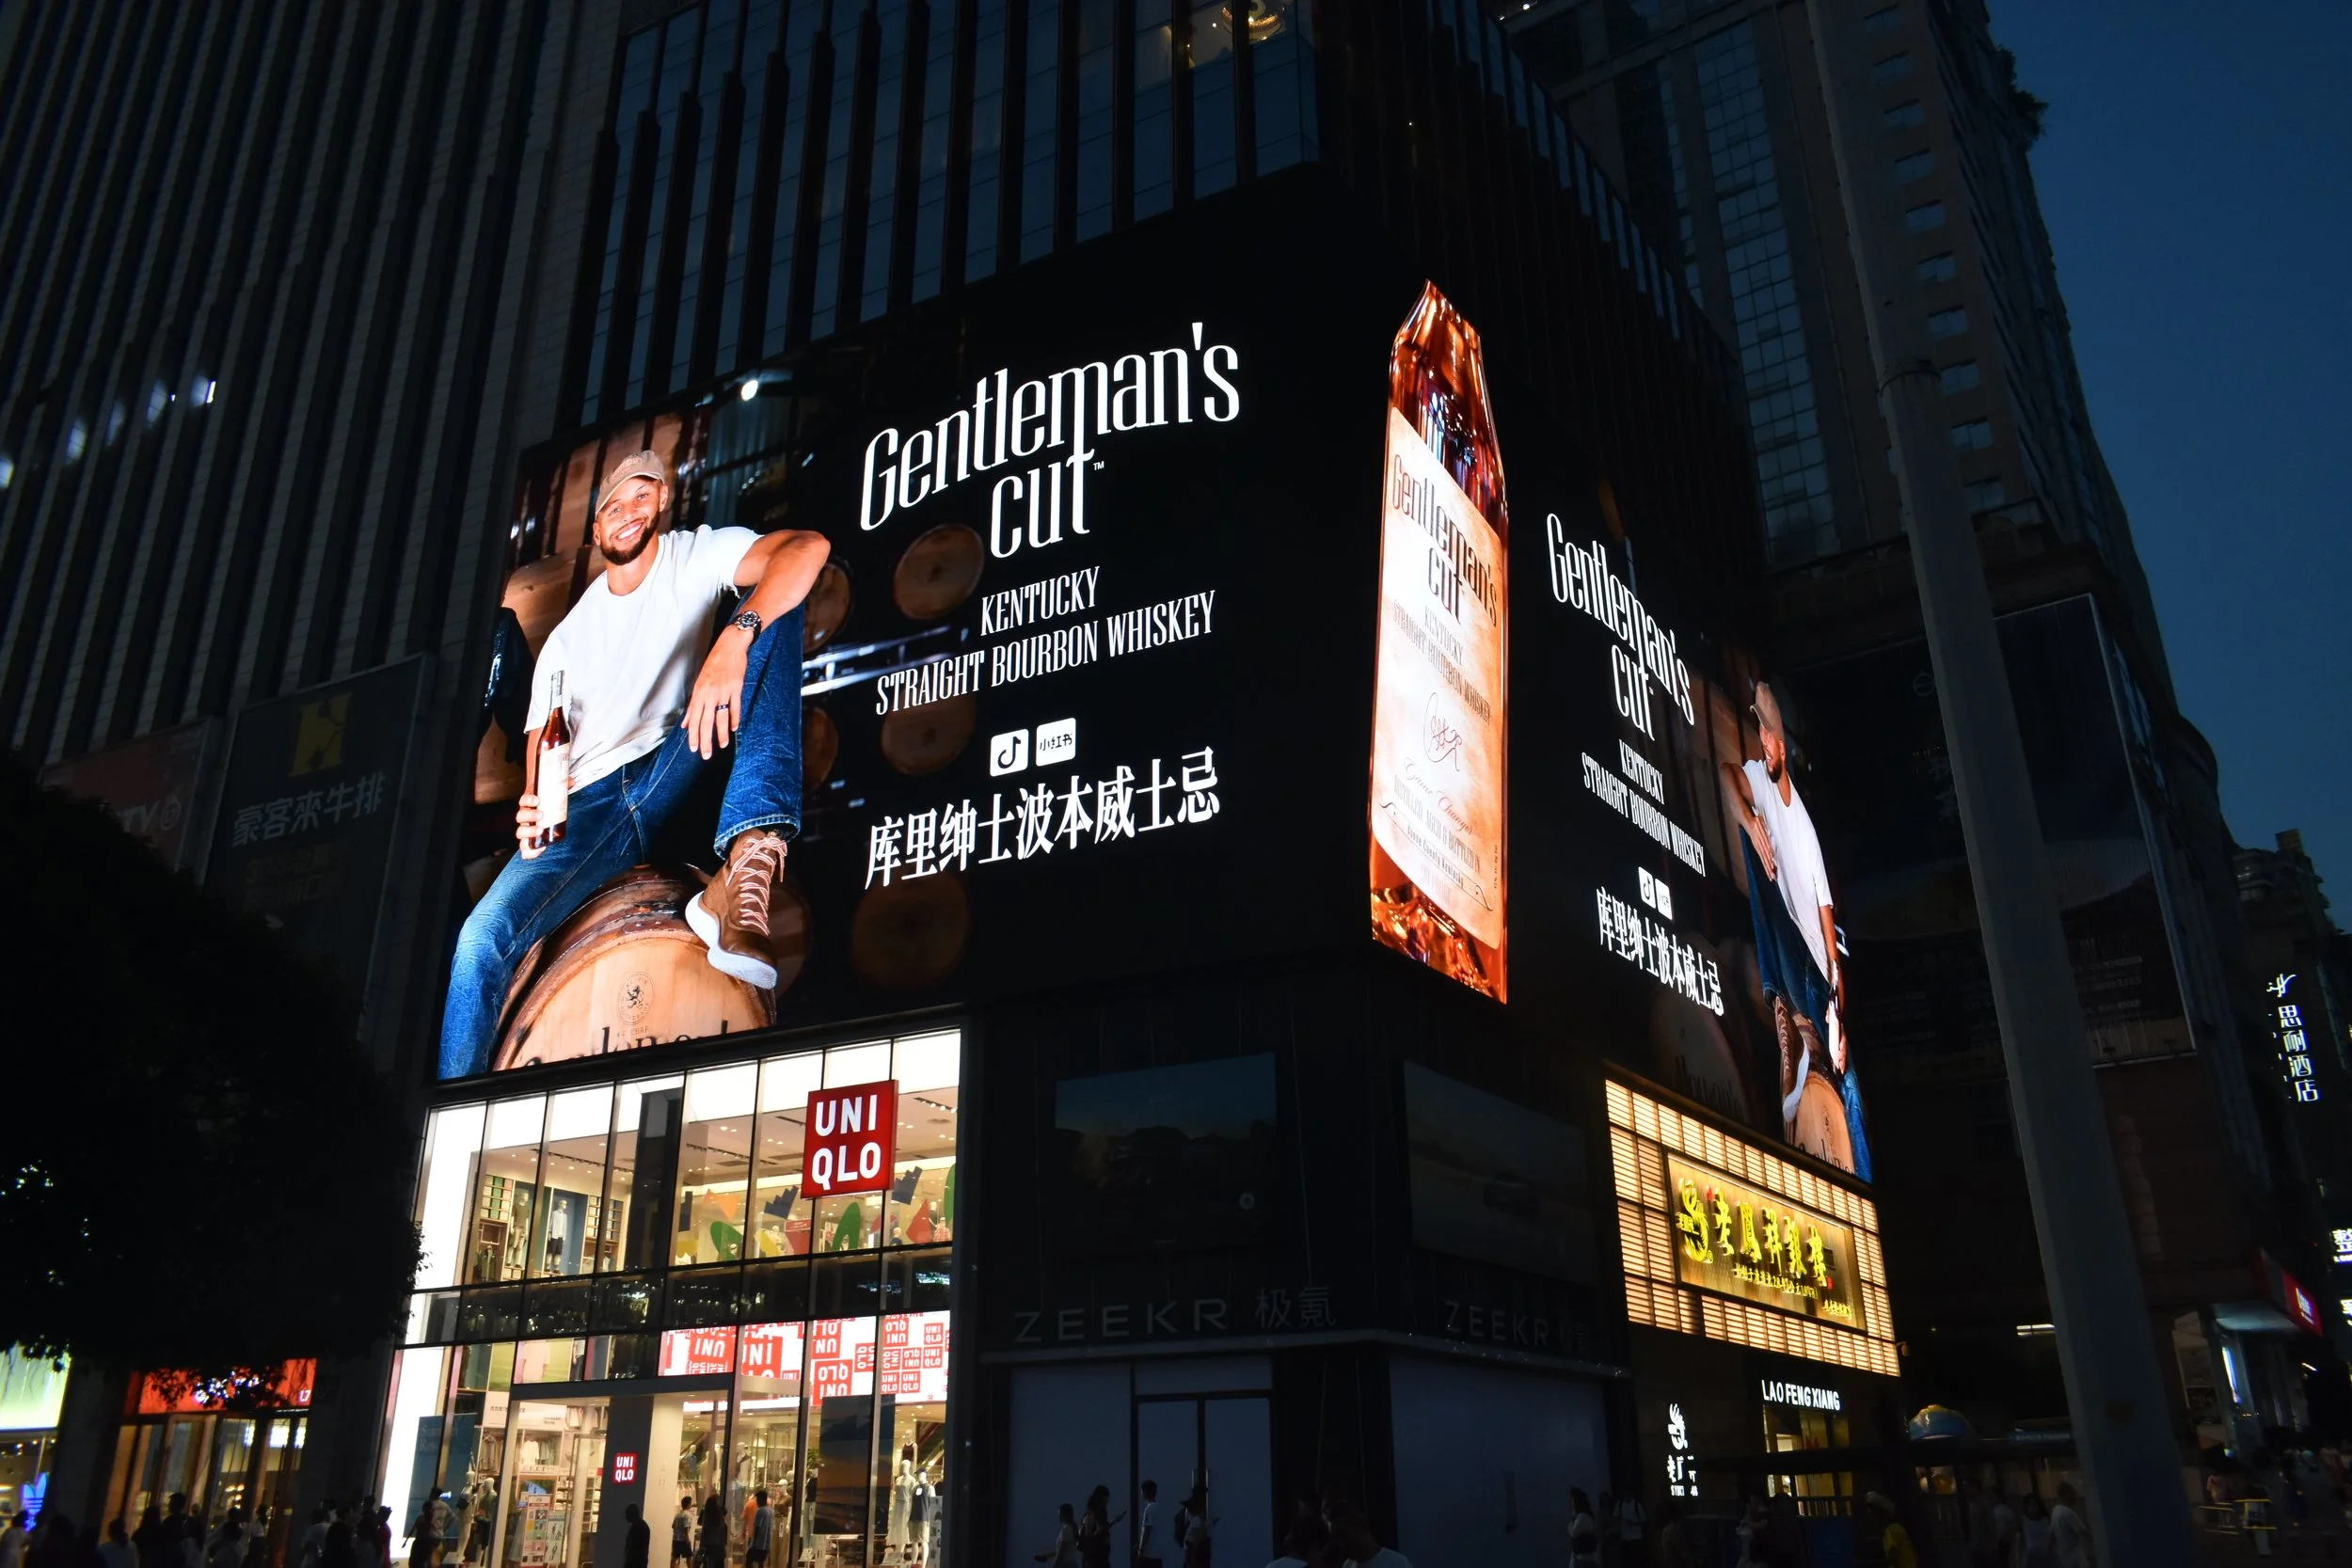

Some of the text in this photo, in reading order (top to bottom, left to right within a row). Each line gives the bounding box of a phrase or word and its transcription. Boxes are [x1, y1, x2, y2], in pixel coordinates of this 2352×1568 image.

[860, 323, 1240, 531] Gentleman's
[1392, 454, 1497, 627] Gentleman's
[980, 566, 1100, 636] KENTUCKY
[1547, 514, 1694, 725] Gentleman's
[876, 590, 1216, 715] STRAIGHT BOURBON WHISKEY
[1393, 600, 1426, 654] STRAIGHT
[1428, 638, 1462, 696] BOURBON
[1464, 677, 1491, 724] WHISKEY
[1424, 606, 1463, 666] KENTUCKY
[1040, 734, 1073, 751] 小红书
[1619, 739, 1664, 804] KENTUCKY
[865, 746, 1220, 890] 库里绅士波本威士忌
[1581, 752, 1706, 877] STRAIGHT BOURBON WHISKEY
[815, 1094, 878, 1136] UNI
[811, 1142, 882, 1191] QLO
[1014, 1285, 1337, 1343] ZEEKR 极氪
[1445, 1300, 1549, 1347] ZEEKR
[1762, 1380, 1840, 1411] LAO FENG XIANG
[615, 1469, 633, 1482] QLO
[616, 1456, 633, 1467] UNI
